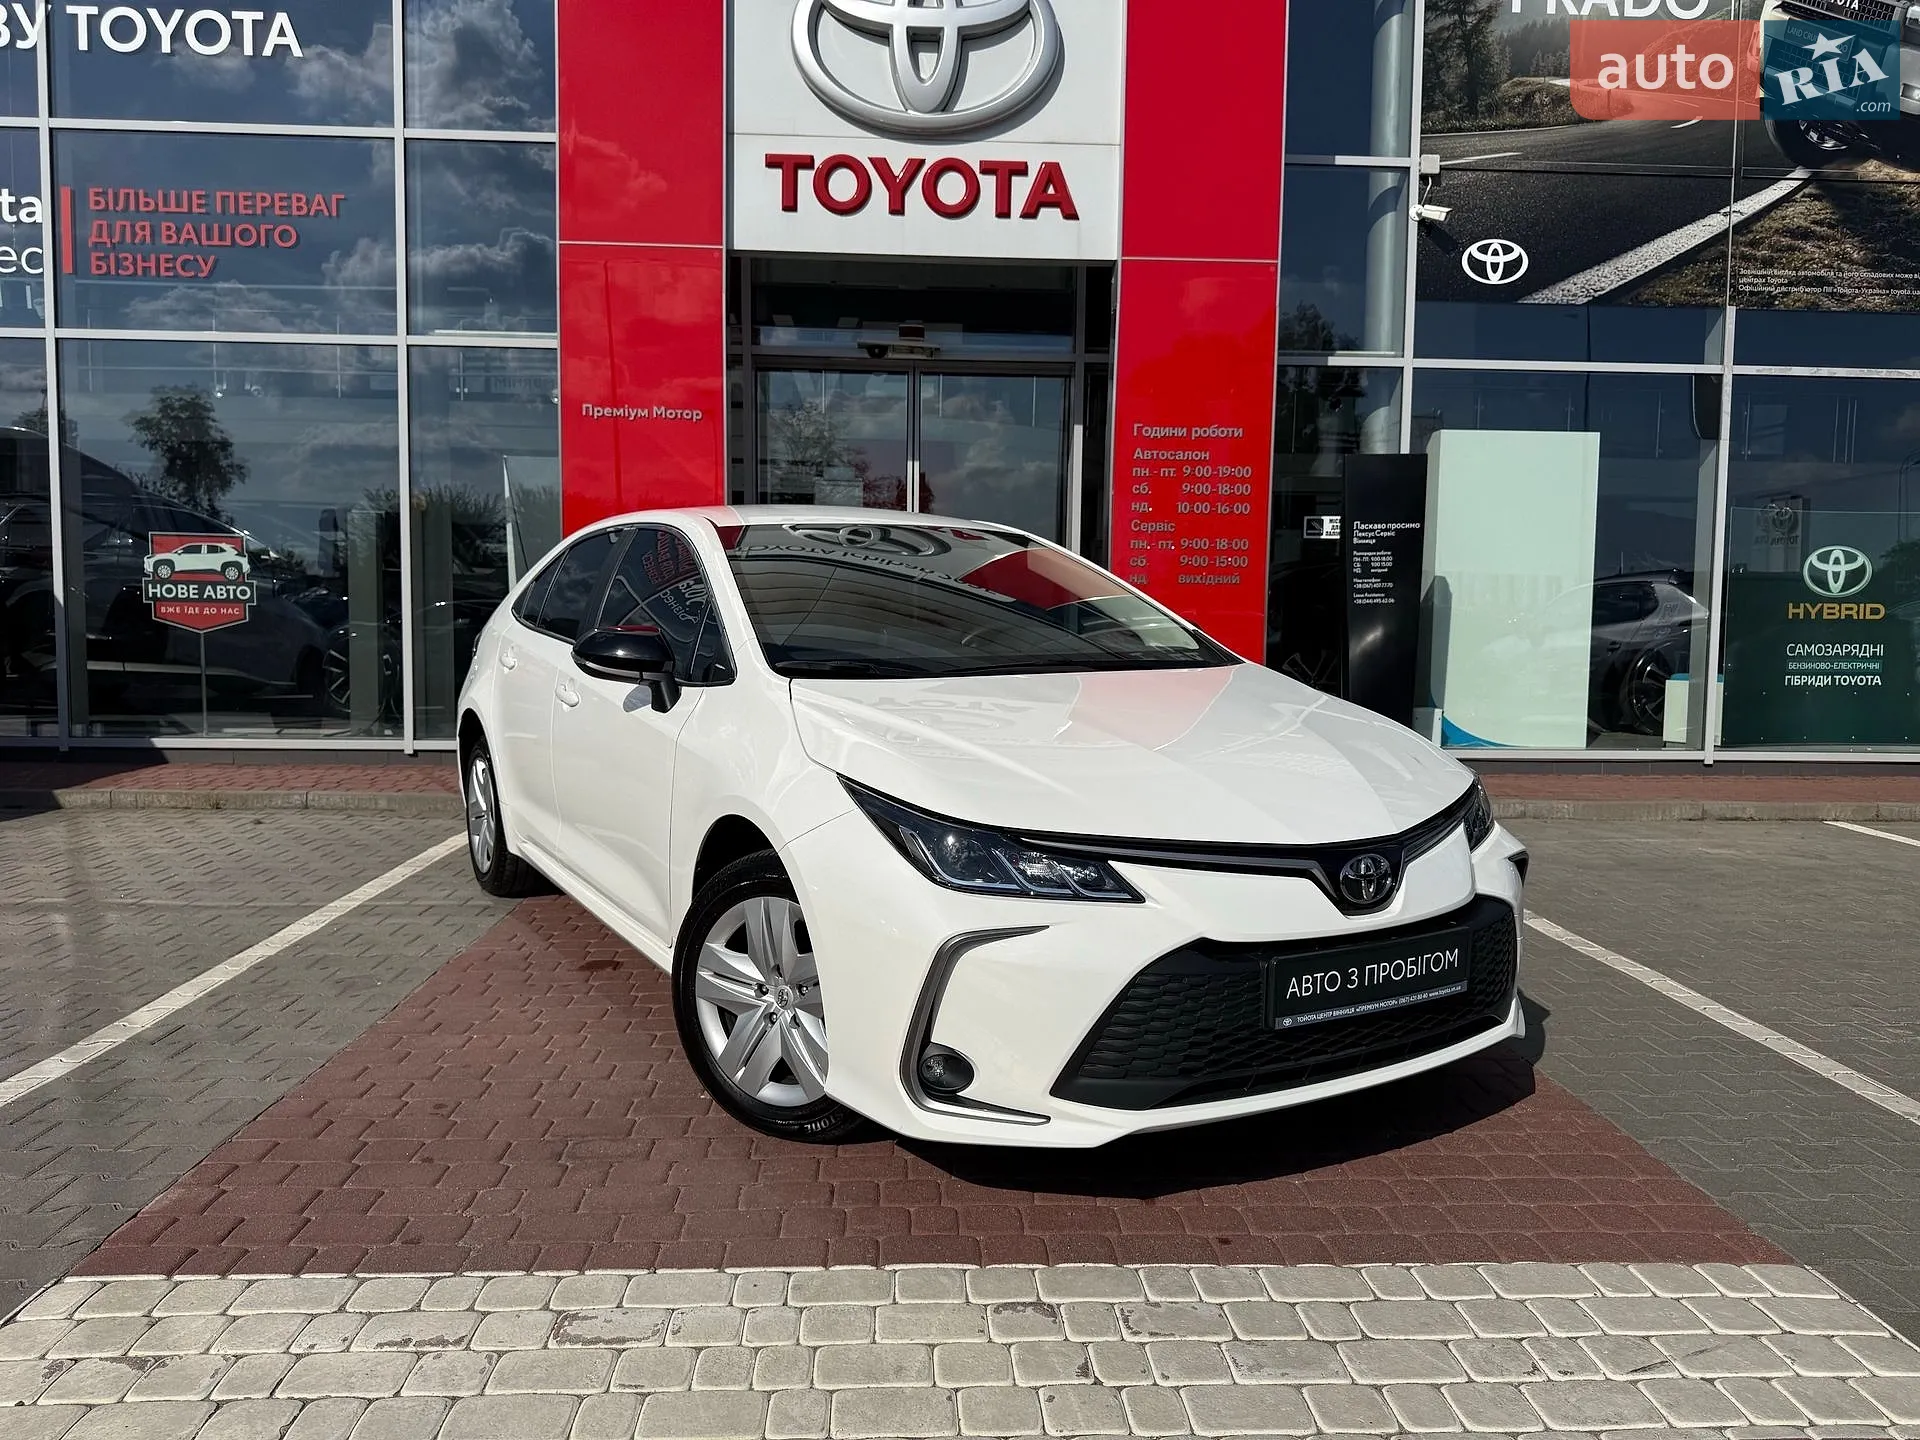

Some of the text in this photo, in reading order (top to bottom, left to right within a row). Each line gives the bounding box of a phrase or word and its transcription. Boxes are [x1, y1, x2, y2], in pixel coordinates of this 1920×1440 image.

[66, 5, 304, 57] TOYOTA
[764, 153, 1080, 221] TOYOTA
[89, 188, 345, 217] БІЛЬШЕ ПЕРЕВАГ
[88, 220, 298, 248] ДЛЯ ВАШОГО
[91, 252, 217, 278] БІЗНЕСУ
[582, 403, 702, 421] Преміум Мотор
[1133, 423, 1244, 440] Години роботи
[1133, 448, 1210, 461] Автосалон
[1182, 466, 1252, 478] 9:00-19:00
[1132, 483, 1251, 495] сб. 9:00-18:00
[1131, 502, 1250, 514] нд. 10:00-16:00
[1131, 520, 1176, 533] Сервіс
[1353, 521, 1420, 530] Ласкаво просимо
[1180, 538, 1248, 550] 9:00-18:00
[1179, 556, 1248, 567] 9:00-15:00
[1178, 572, 1240, 585] вихідний
[148, 583, 251, 600] НОВЕ АВТО
[160, 605, 240, 615] ВЖЕ ЇДЕ ДО НАС
[1787, 602, 1886, 620] HYBRID
[1786, 643, 1884, 658] САМОЗАРЯДНІ
[1788, 661, 1880, 670] БЕНЗИНОВО-ЕЛЕКТРИЧНІ
[1784, 675, 1882, 687] ГІБРИДИ TOYOTA
[1286, 948, 1459, 1000] АВТО З ПРОБІГОМ
